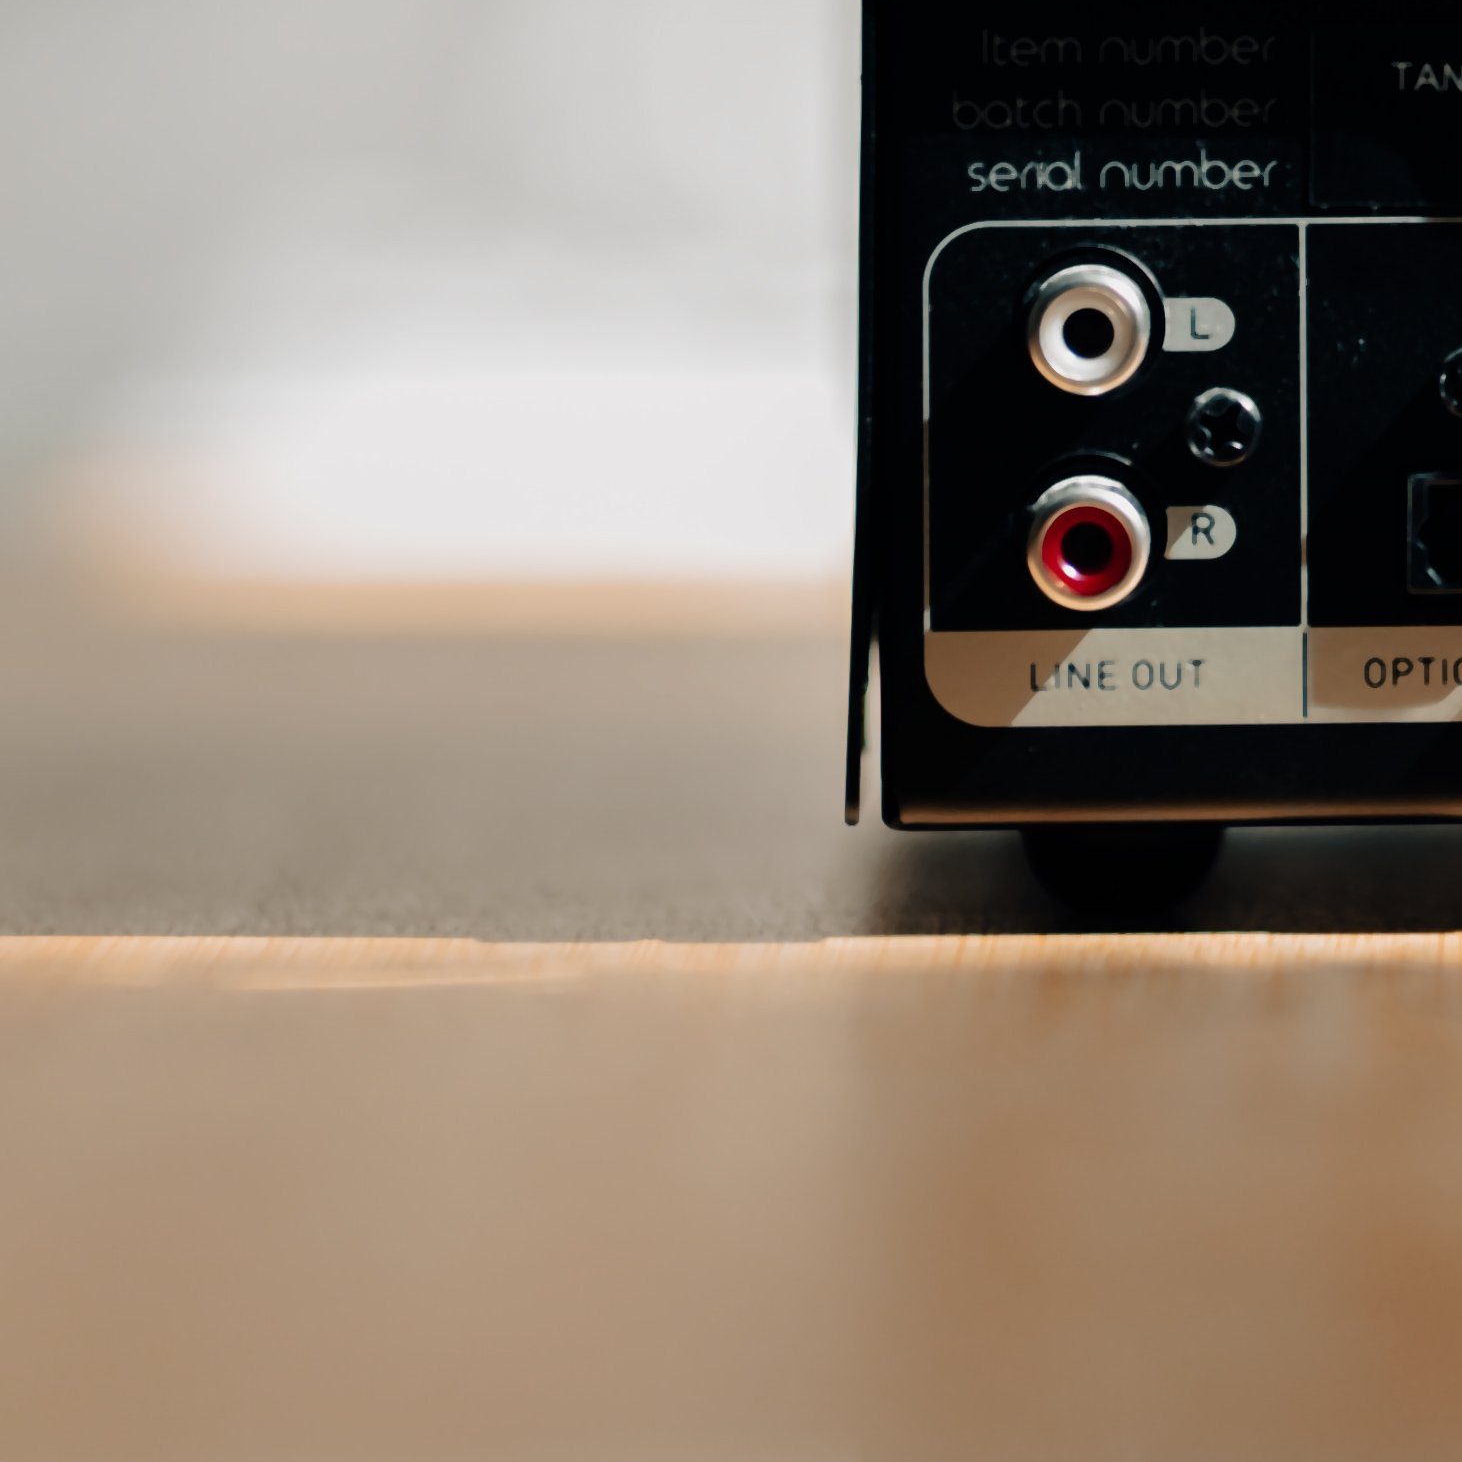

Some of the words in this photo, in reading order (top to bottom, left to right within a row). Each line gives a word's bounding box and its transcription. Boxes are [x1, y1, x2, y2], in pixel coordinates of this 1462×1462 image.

[980, 28, 1083, 67] Item
[1099, 26, 1277, 66] number
[952, 88, 1083, 129] batch
[1099, 88, 1279, 128] number
[967, 150, 1083, 192] serial
[1099, 148, 1279, 190] number
[1190, 305, 1209, 338] L
[1191, 513, 1214, 544] R
[1029, 662, 1117, 692] LINE
[1132, 660, 1205, 690] OUT
